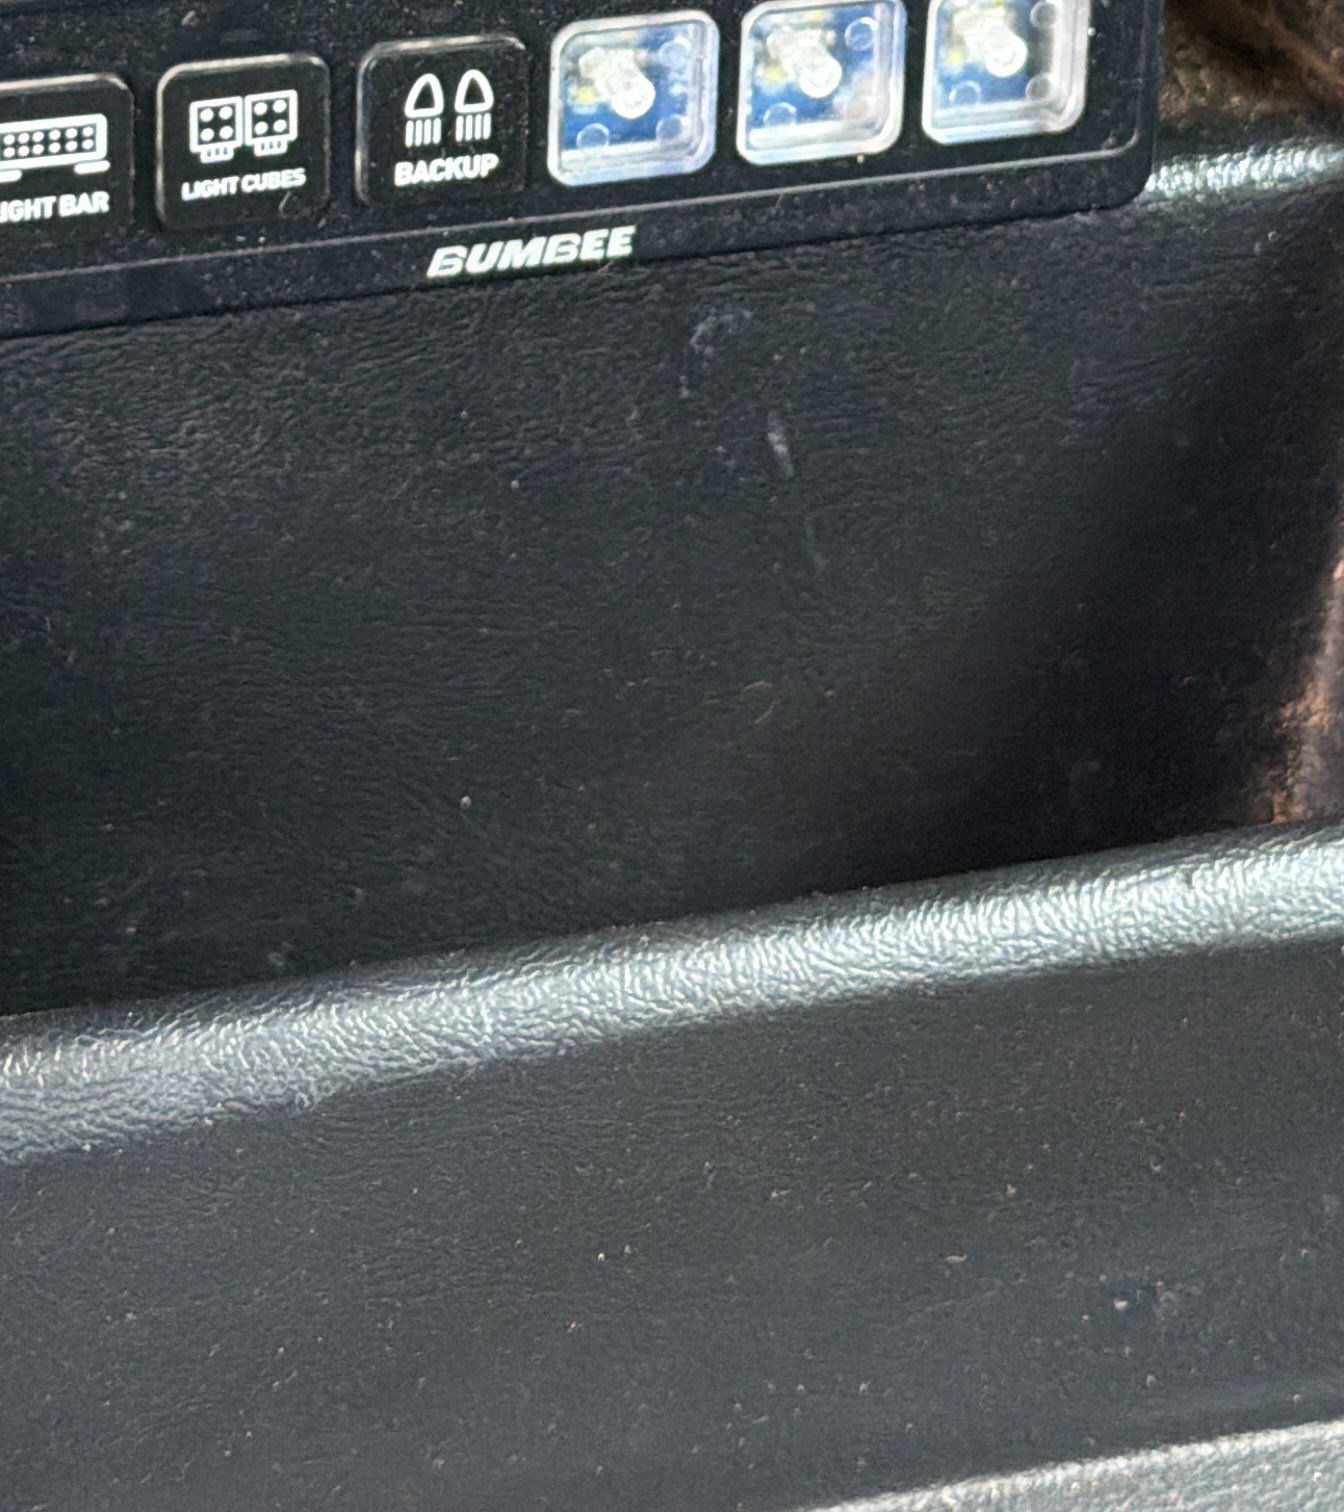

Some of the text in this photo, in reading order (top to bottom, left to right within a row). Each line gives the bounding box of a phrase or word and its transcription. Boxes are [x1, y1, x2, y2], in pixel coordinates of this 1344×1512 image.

[180, 166, 307, 202] LIGHT CUBES
[393, 153, 500, 188] BACKUP
[58, 190, 110, 218] BAR
[425, 225, 637, 279] BUMBEE
